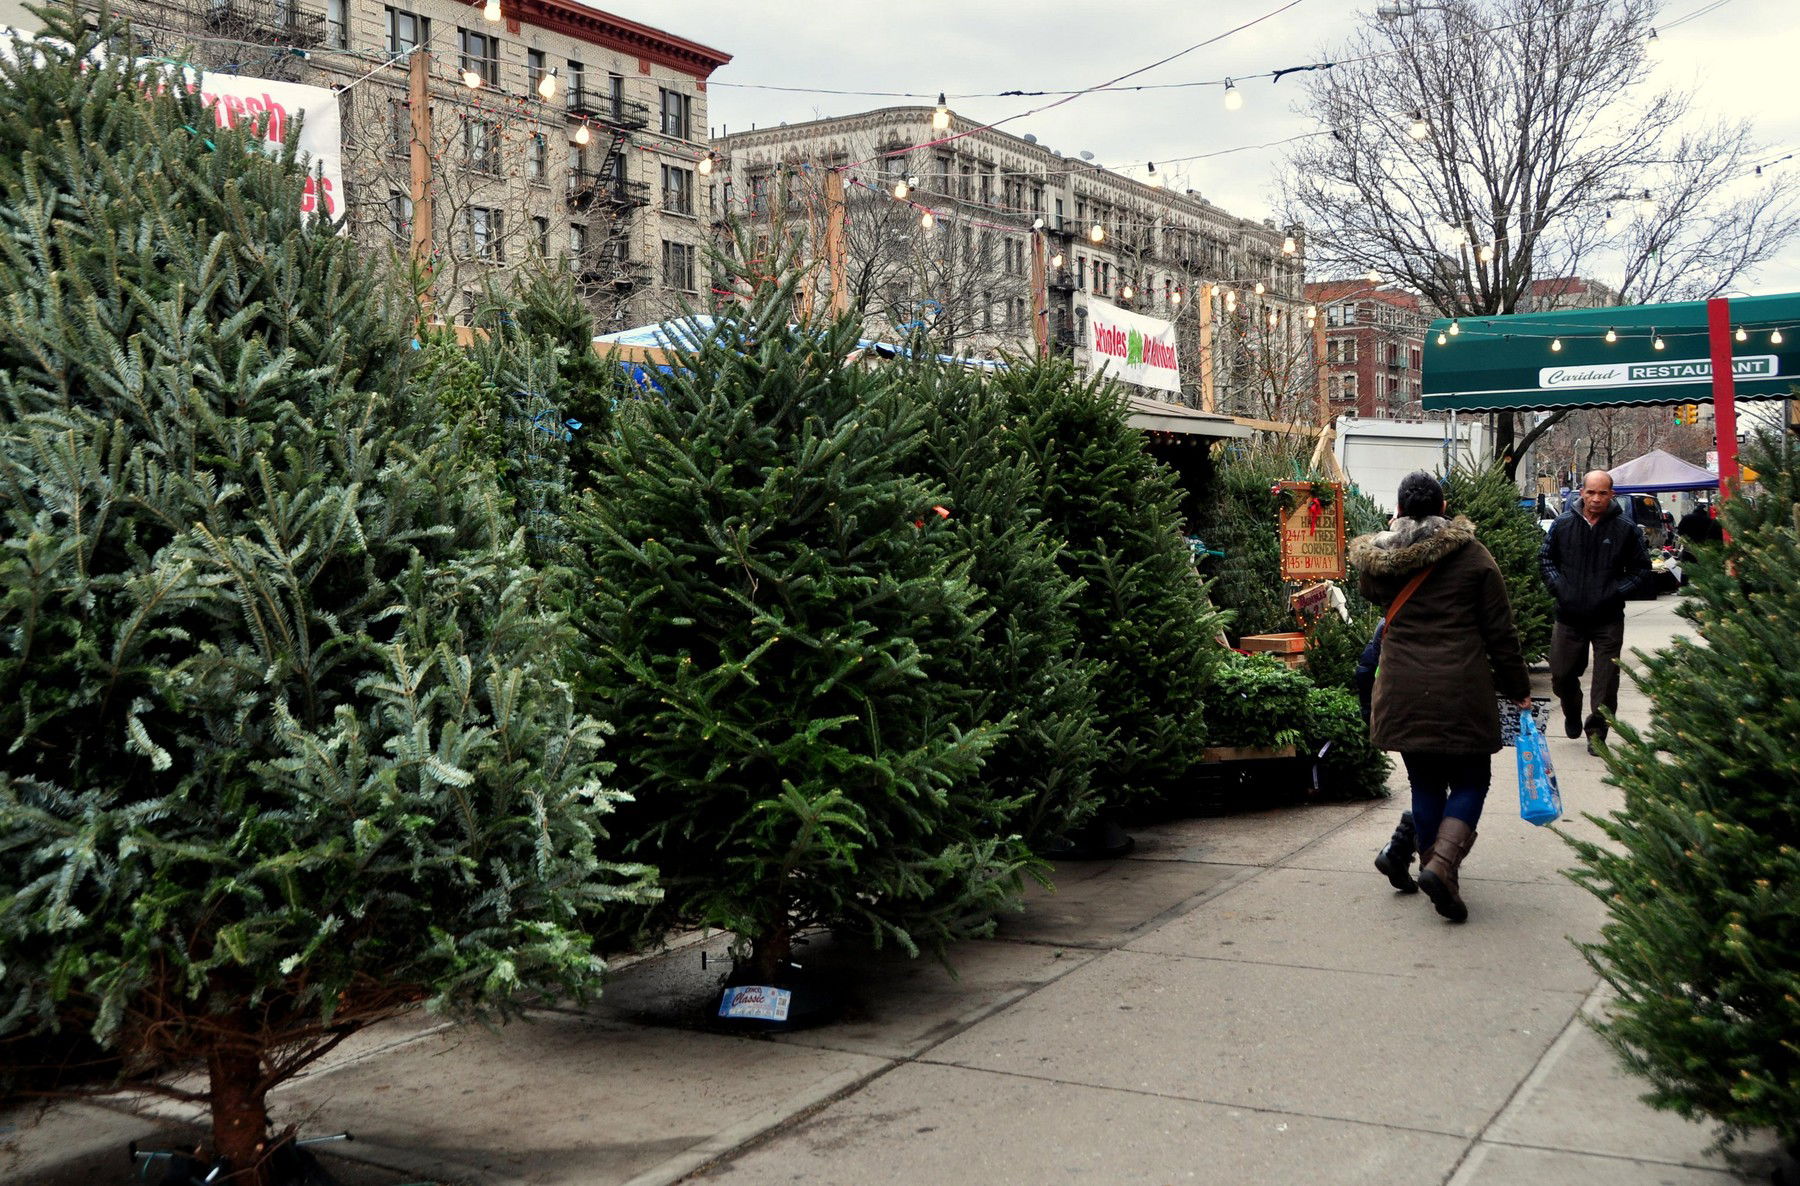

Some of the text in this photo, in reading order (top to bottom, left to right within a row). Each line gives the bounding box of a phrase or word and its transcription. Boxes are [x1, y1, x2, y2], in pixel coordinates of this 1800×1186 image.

[1547, 361, 1765, 386] Caridad RESTAUNT
[1286, 530, 1306, 541] 24/7
[1314, 530, 1336, 542] TREE
[1301, 543, 1337, 555] CORNER
[1305, 557, 1333, 568] B/WAY
[732, 992, 765, 1007] Classic
